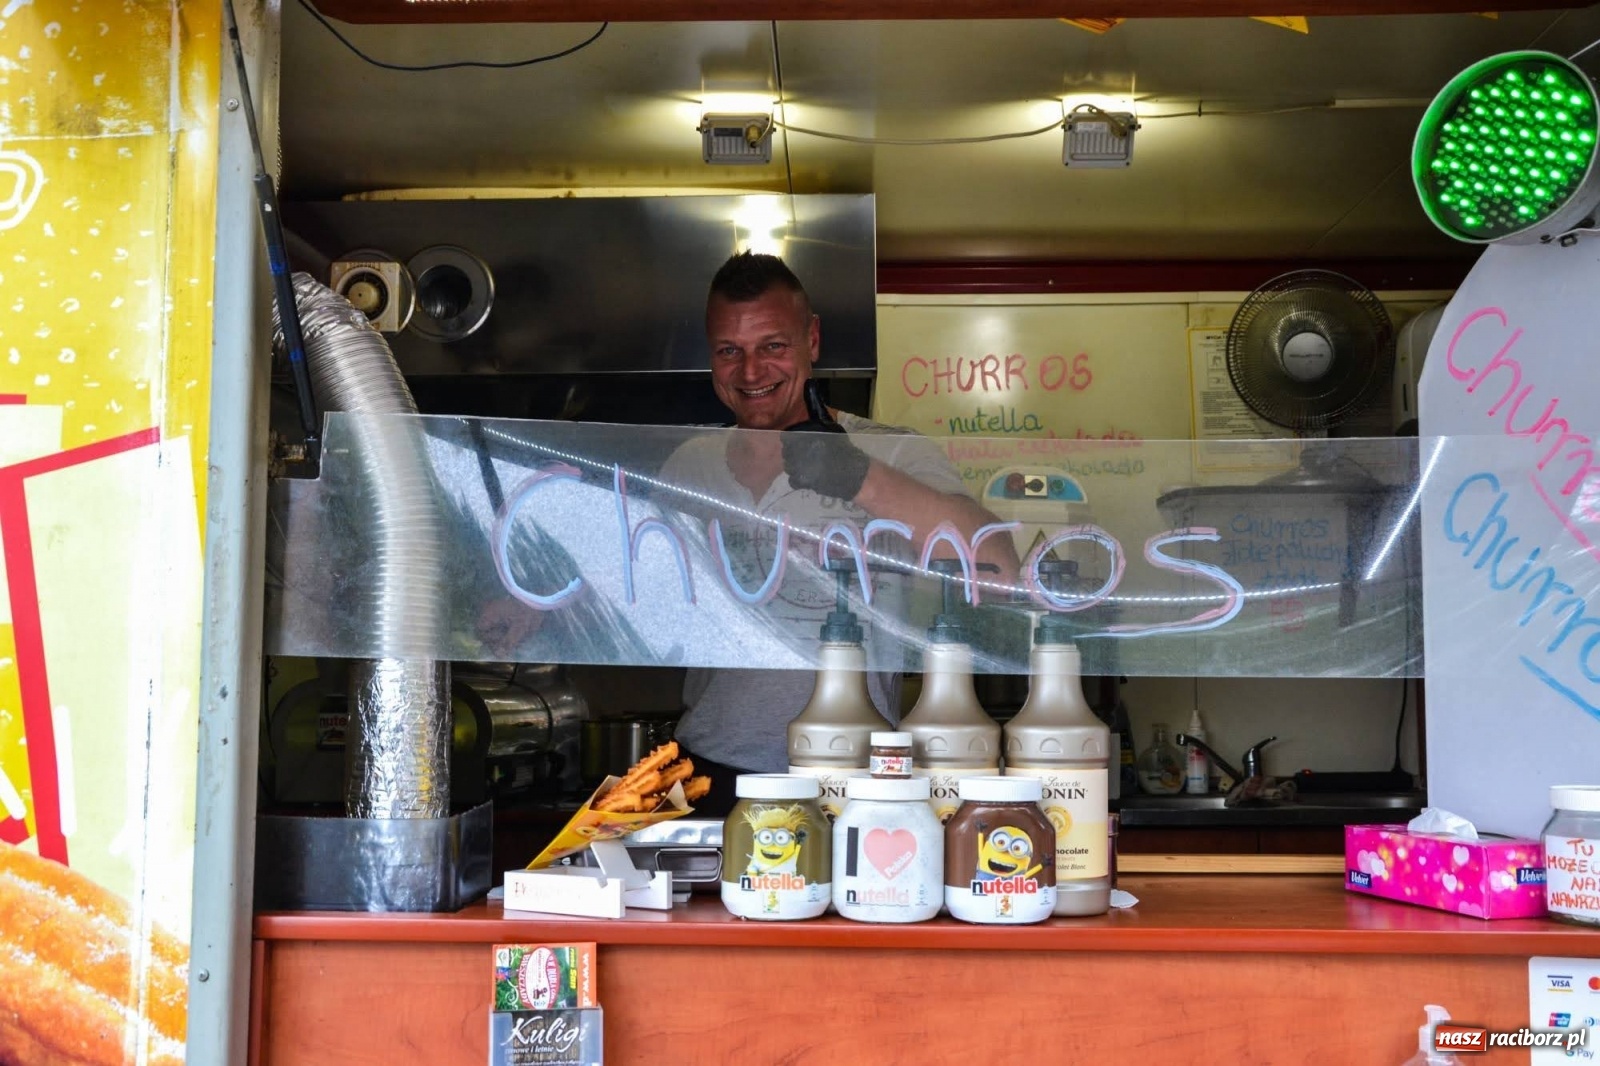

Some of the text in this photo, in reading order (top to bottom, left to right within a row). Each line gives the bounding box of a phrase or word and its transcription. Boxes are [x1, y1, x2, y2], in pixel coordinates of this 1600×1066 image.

[949, 405, 1043, 434] nutella
[1446, 306, 1600, 523] Churr
[492, 463, 1245, 638] Churros
[320, 714, 347, 727] nute
[818, 786, 846, 798] ONI
[1041, 787, 1086, 799] ONIN
[1566, 837, 1594, 856] TU
[741, 872, 805, 891] nutella
[971, 876, 1038, 894] nutella
[1570, 876, 1600, 892] NA
[846, 886, 910, 904] nutella
[1551, 891, 1600, 911] NAWRZ
[1551, 980, 1571, 988] VISA
[500, 1016, 589, 1052] Kuligi
[535, 1045, 554, 1053] letnie
[1576, 1049, 1595, 1059] Pay
